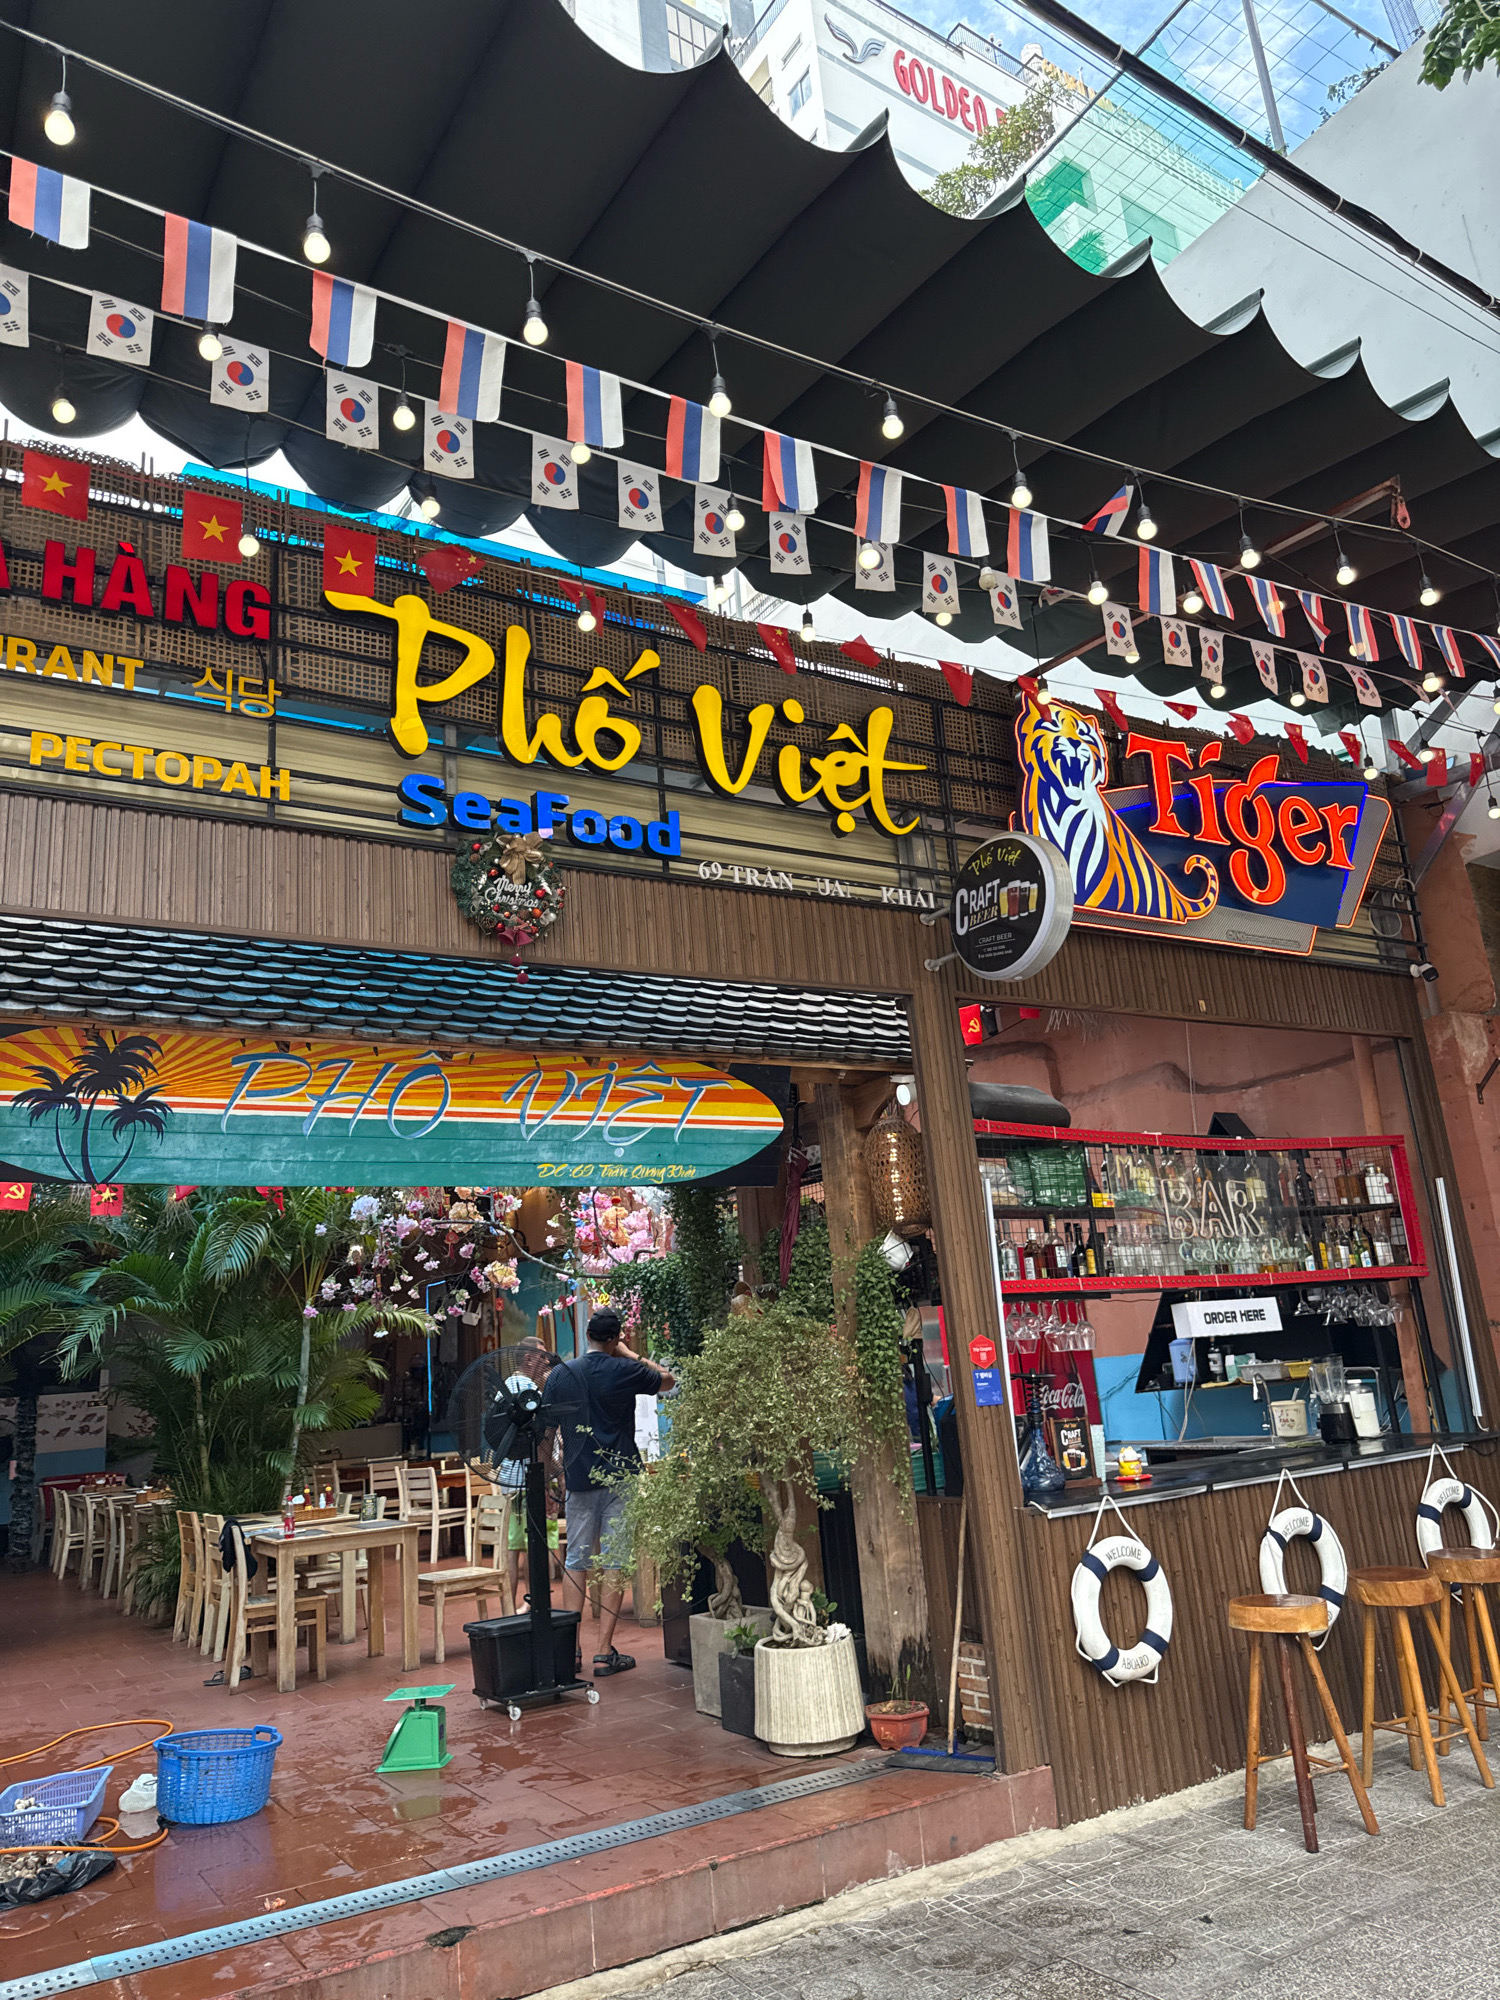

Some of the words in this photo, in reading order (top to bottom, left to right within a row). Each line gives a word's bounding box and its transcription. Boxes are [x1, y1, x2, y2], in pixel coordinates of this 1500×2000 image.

[893, 50, 989, 137] GOLDEN
[42, 539, 271, 640] HÀNG
[0, 635, 144, 690] RANT
[192, 667, 282, 718] 식당
[325, 590, 661, 771] Phố
[692, 684, 927, 836] Việt
[30, 731, 291, 801] РЕСТОРАН
[1125, 732, 1359, 906] Tiger
[698, 860, 723, 881] 69
[968, 847, 994, 876] Phố
[997, 846, 1021, 867] Việt
[485, 887, 539, 907] Christmas
[493, 875, 532, 897] Merry
[956, 878, 1000, 936] CRAFT
[969, 905, 999, 927] BEER
[978, 935, 996, 944] CRAFT
[996, 932, 1012, 941] BEER
[501, 1060, 734, 1157] VIỆT
[1160, 1179, 1262, 1239] BAR
[1270, 1237, 1301, 1260] Beer
[1204, 1311, 1238, 1325] ORDER
[1240, 1309, 1266, 1322] HERE
[1061, 1429, 1081, 1445] CRAFT
[1437, 1485, 1460, 1506] WELCOME
[1282, 1516, 1310, 1538] WELCOME
[1105, 1545, 1142, 1561] WELCOME
[1121, 1655, 1150, 1671] ABOARD
